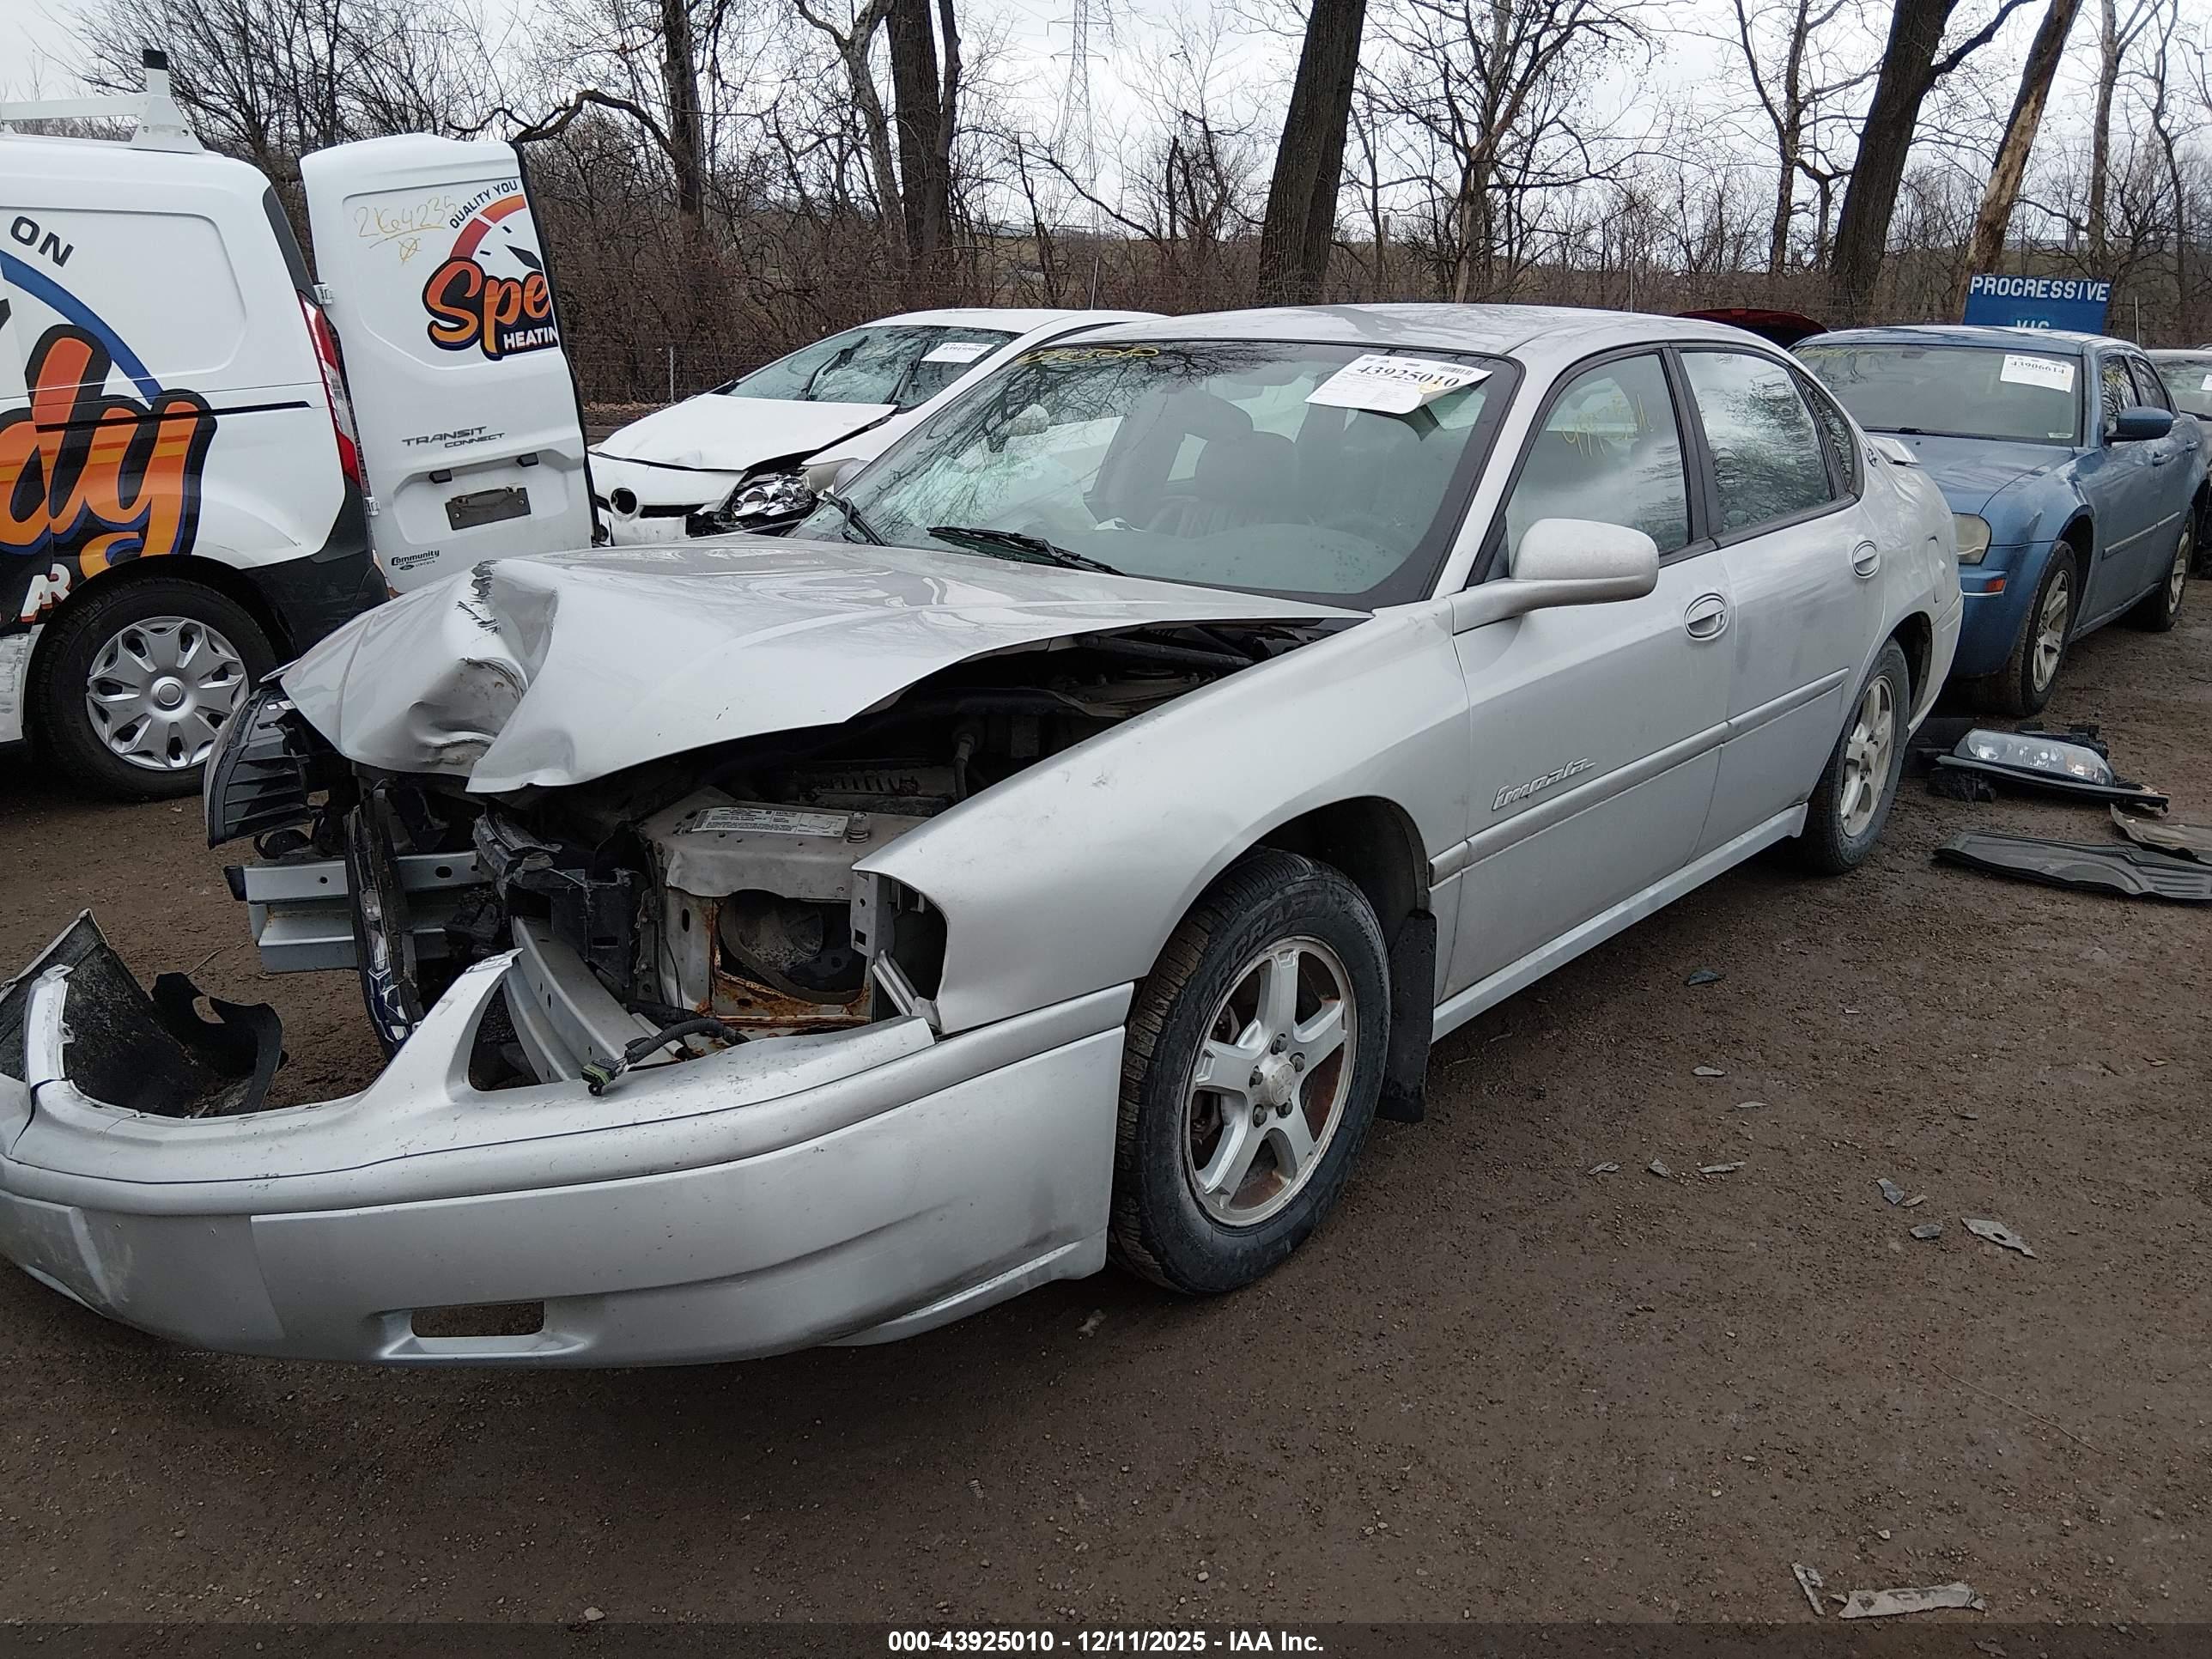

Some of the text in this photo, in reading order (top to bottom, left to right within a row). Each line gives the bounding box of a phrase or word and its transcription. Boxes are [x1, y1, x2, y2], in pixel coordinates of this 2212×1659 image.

[449, 179, 518, 229] QUALITY YOU
[10, 215, 75, 268] ON
[1969, 276, 2111, 301] PROGRESSIVE
[426, 258, 551, 355] Spe
[1357, 364, 1461, 387] 43925010
[402, 426, 487, 447] TRANSIT
[444, 433, 505, 448] CONNECT
[391, 550, 440, 567] Community
[1492, 757, 1596, 811] Impala
